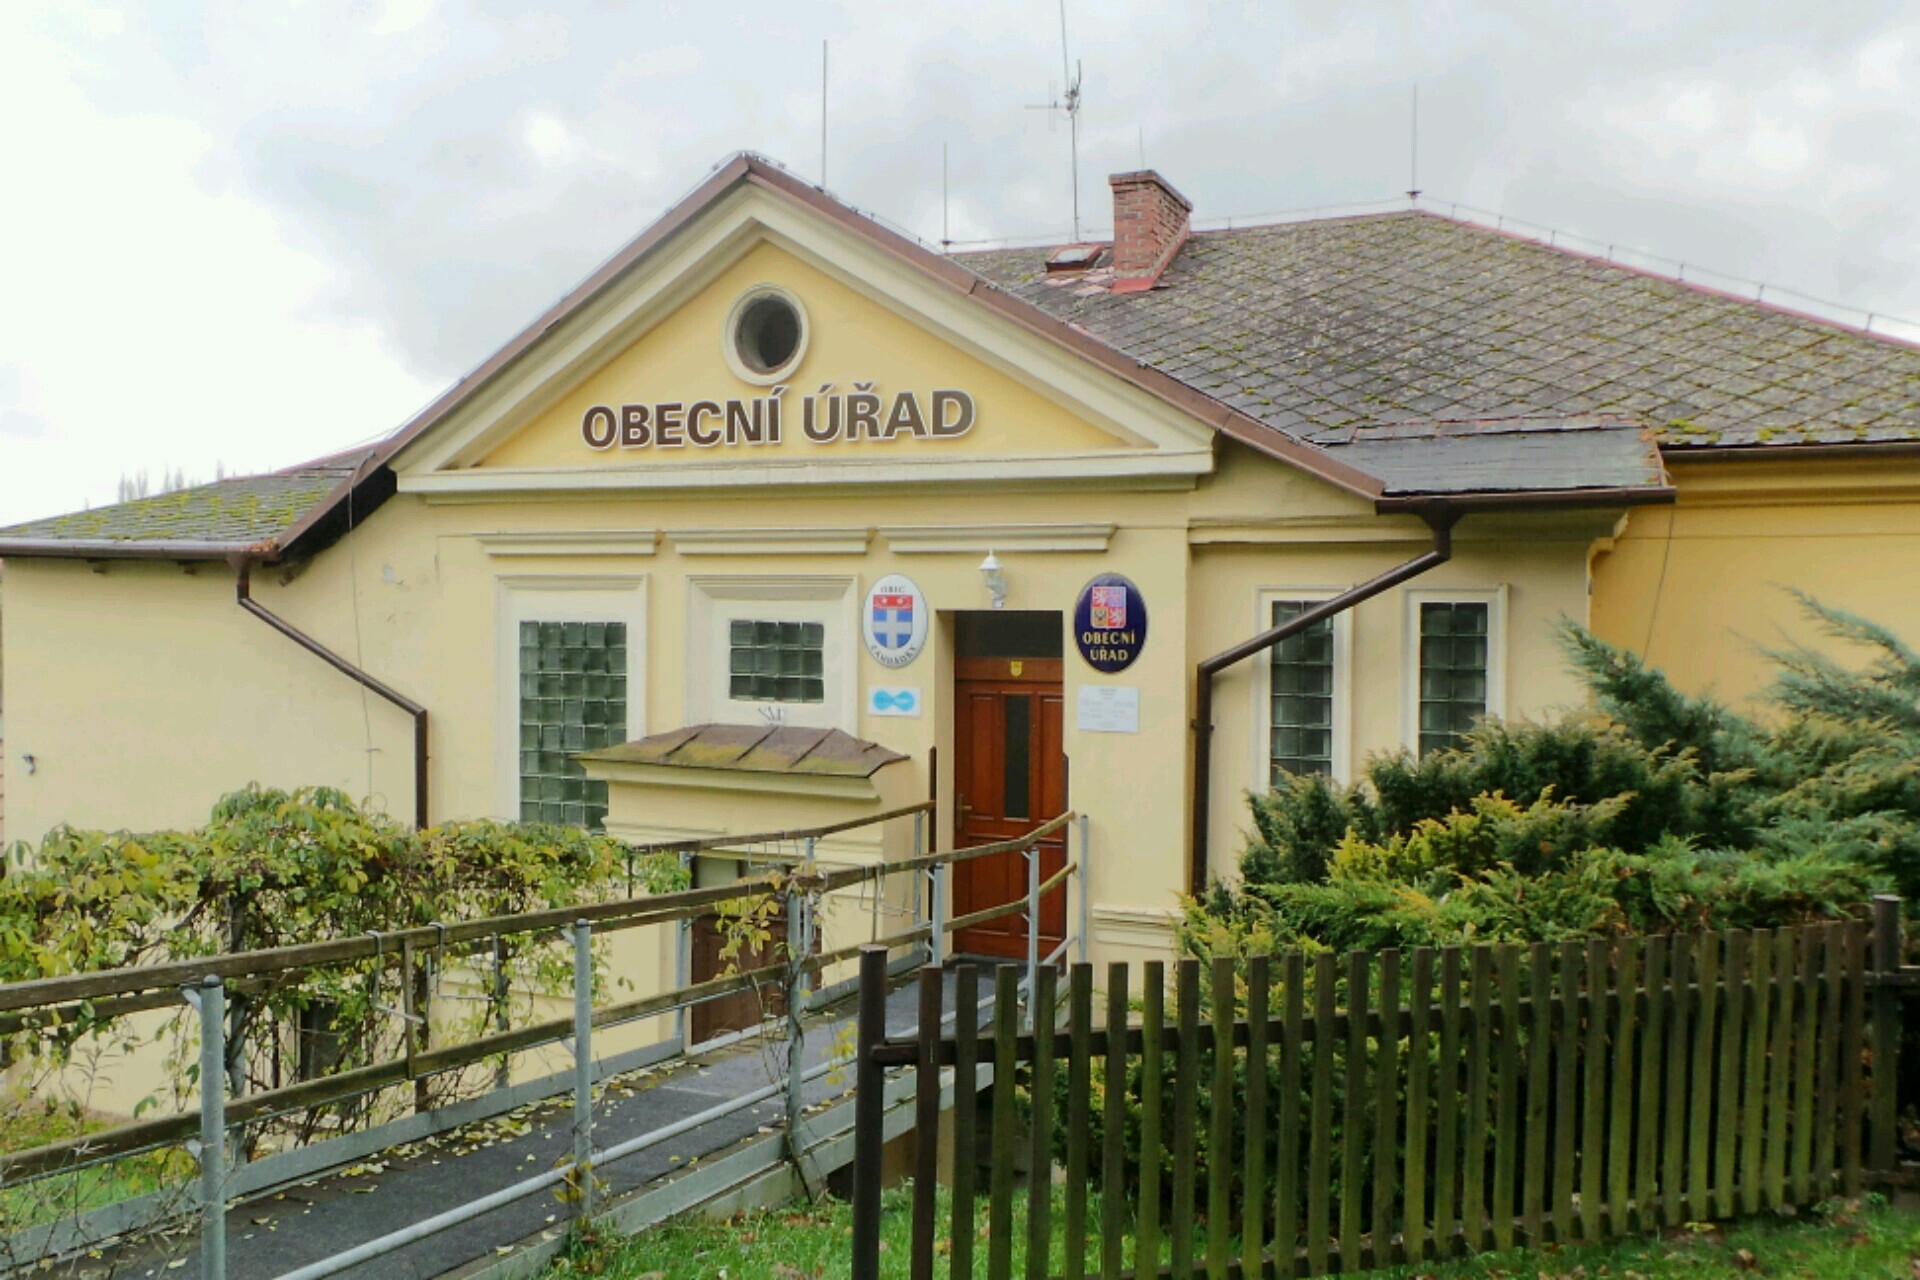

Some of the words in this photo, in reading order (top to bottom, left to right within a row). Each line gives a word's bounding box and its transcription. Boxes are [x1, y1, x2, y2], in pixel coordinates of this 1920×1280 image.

[582, 386, 787, 448] OBECNÍ
[803, 383, 976, 442] ÚŘAD
[1083, 630, 1135, 645] OBECNÍ
[1090, 646, 1129, 661] ÚŘAD
